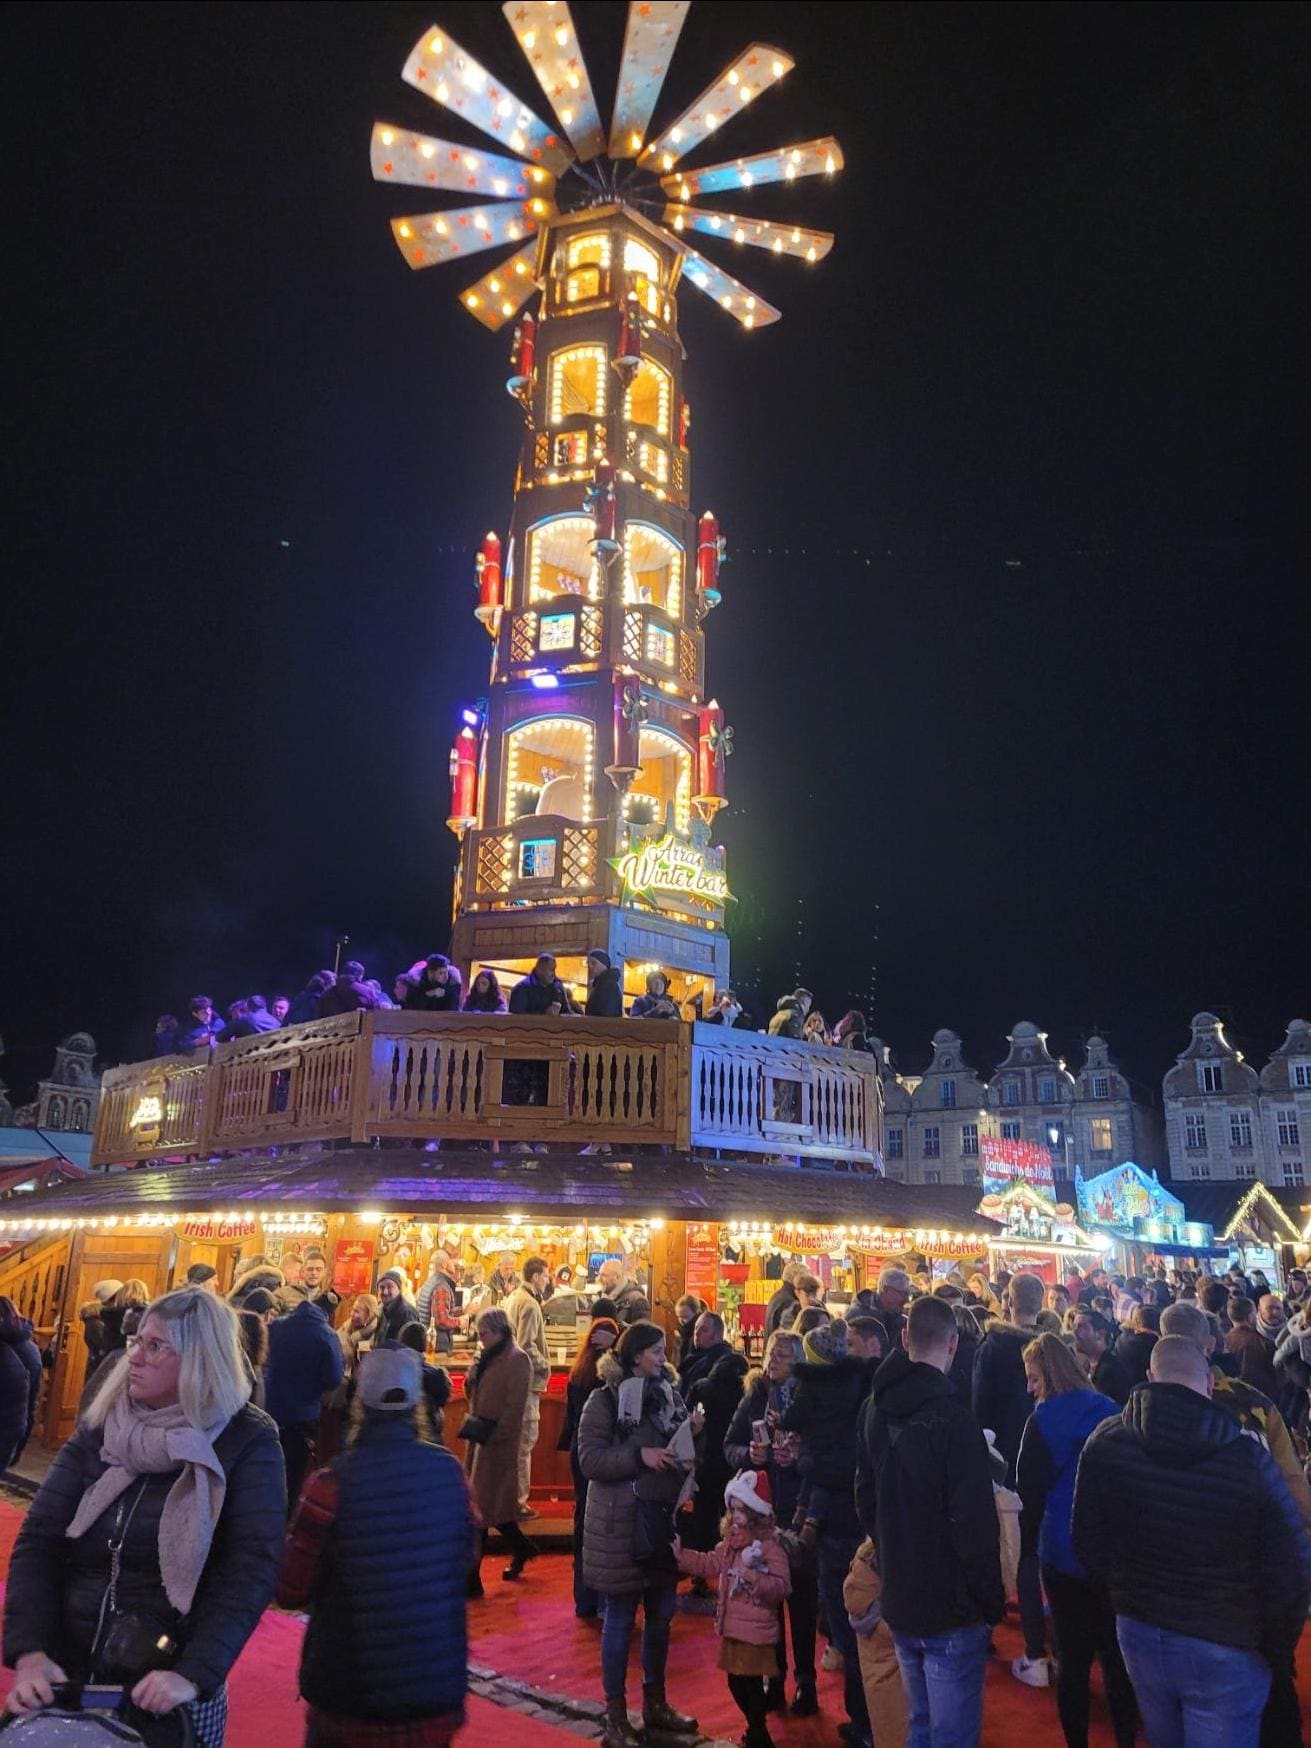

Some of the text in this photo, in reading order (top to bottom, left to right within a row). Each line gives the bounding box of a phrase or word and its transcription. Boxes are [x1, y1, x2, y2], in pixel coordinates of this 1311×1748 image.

[618, 853, 728, 896] Winter bar
[184, 1219, 256, 1238] Irish Coffee
[778, 1228, 793, 1247] Hot
